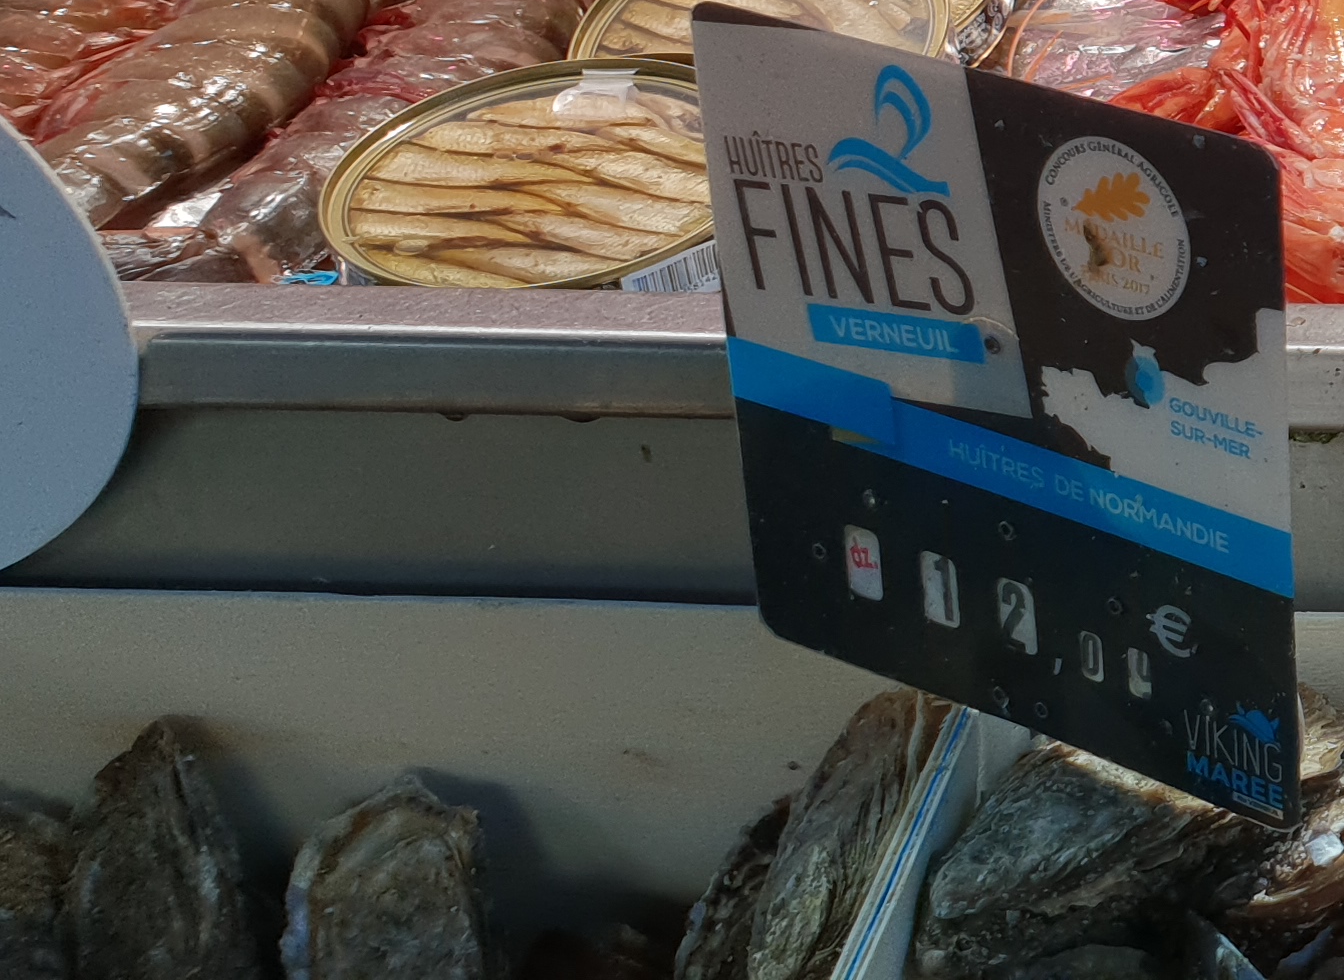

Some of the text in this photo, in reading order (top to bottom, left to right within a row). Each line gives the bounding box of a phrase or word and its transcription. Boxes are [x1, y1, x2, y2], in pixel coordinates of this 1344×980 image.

[724, 130, 824, 184] HUÎTRES
[1045, 143, 1086, 185] CONCOURS
[1137, 161, 1178, 217] AGRICOLE
[732, 179, 975, 316] FINES
[829, 315, 959, 354] VERNEUIL
[1169, 395, 1262, 439] GOUVILLE-
[1170, 420, 1250, 459] SUR-MER
[948, 439, 1230, 554] HUÎTRES DE NORMANDIE
[1184, 710, 1282, 783] VIKING
